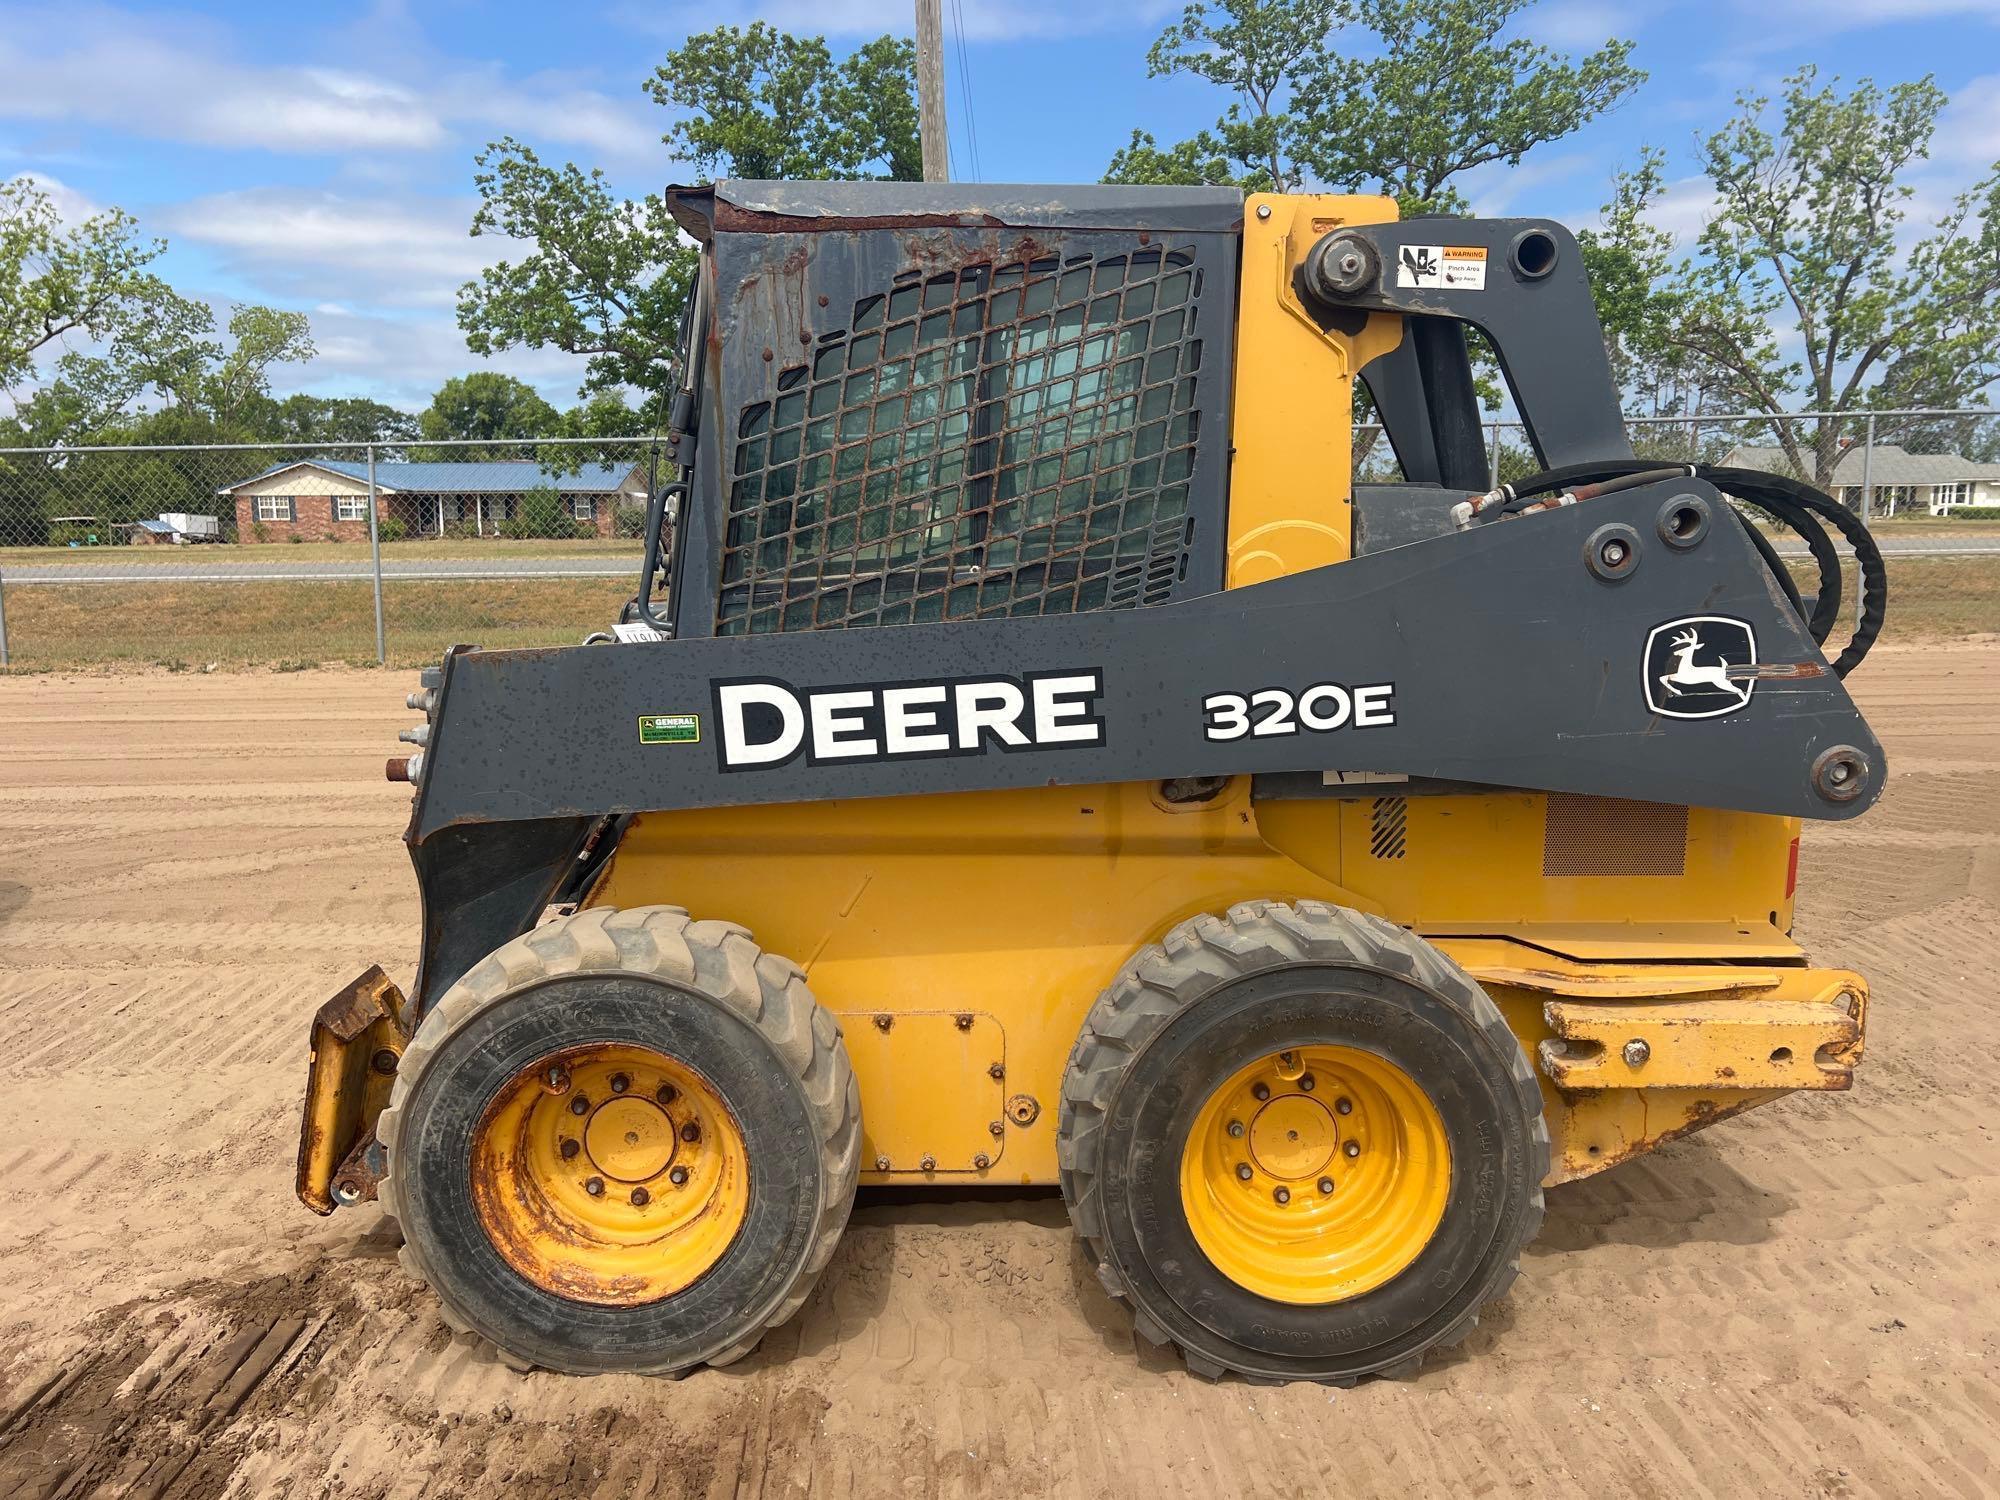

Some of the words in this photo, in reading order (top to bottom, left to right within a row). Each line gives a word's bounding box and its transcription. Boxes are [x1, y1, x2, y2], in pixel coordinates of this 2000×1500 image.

[655, 717, 696, 726] GENERAL
[718, 674, 1100, 766] DEERE
[1205, 684, 1395, 741] 320E
